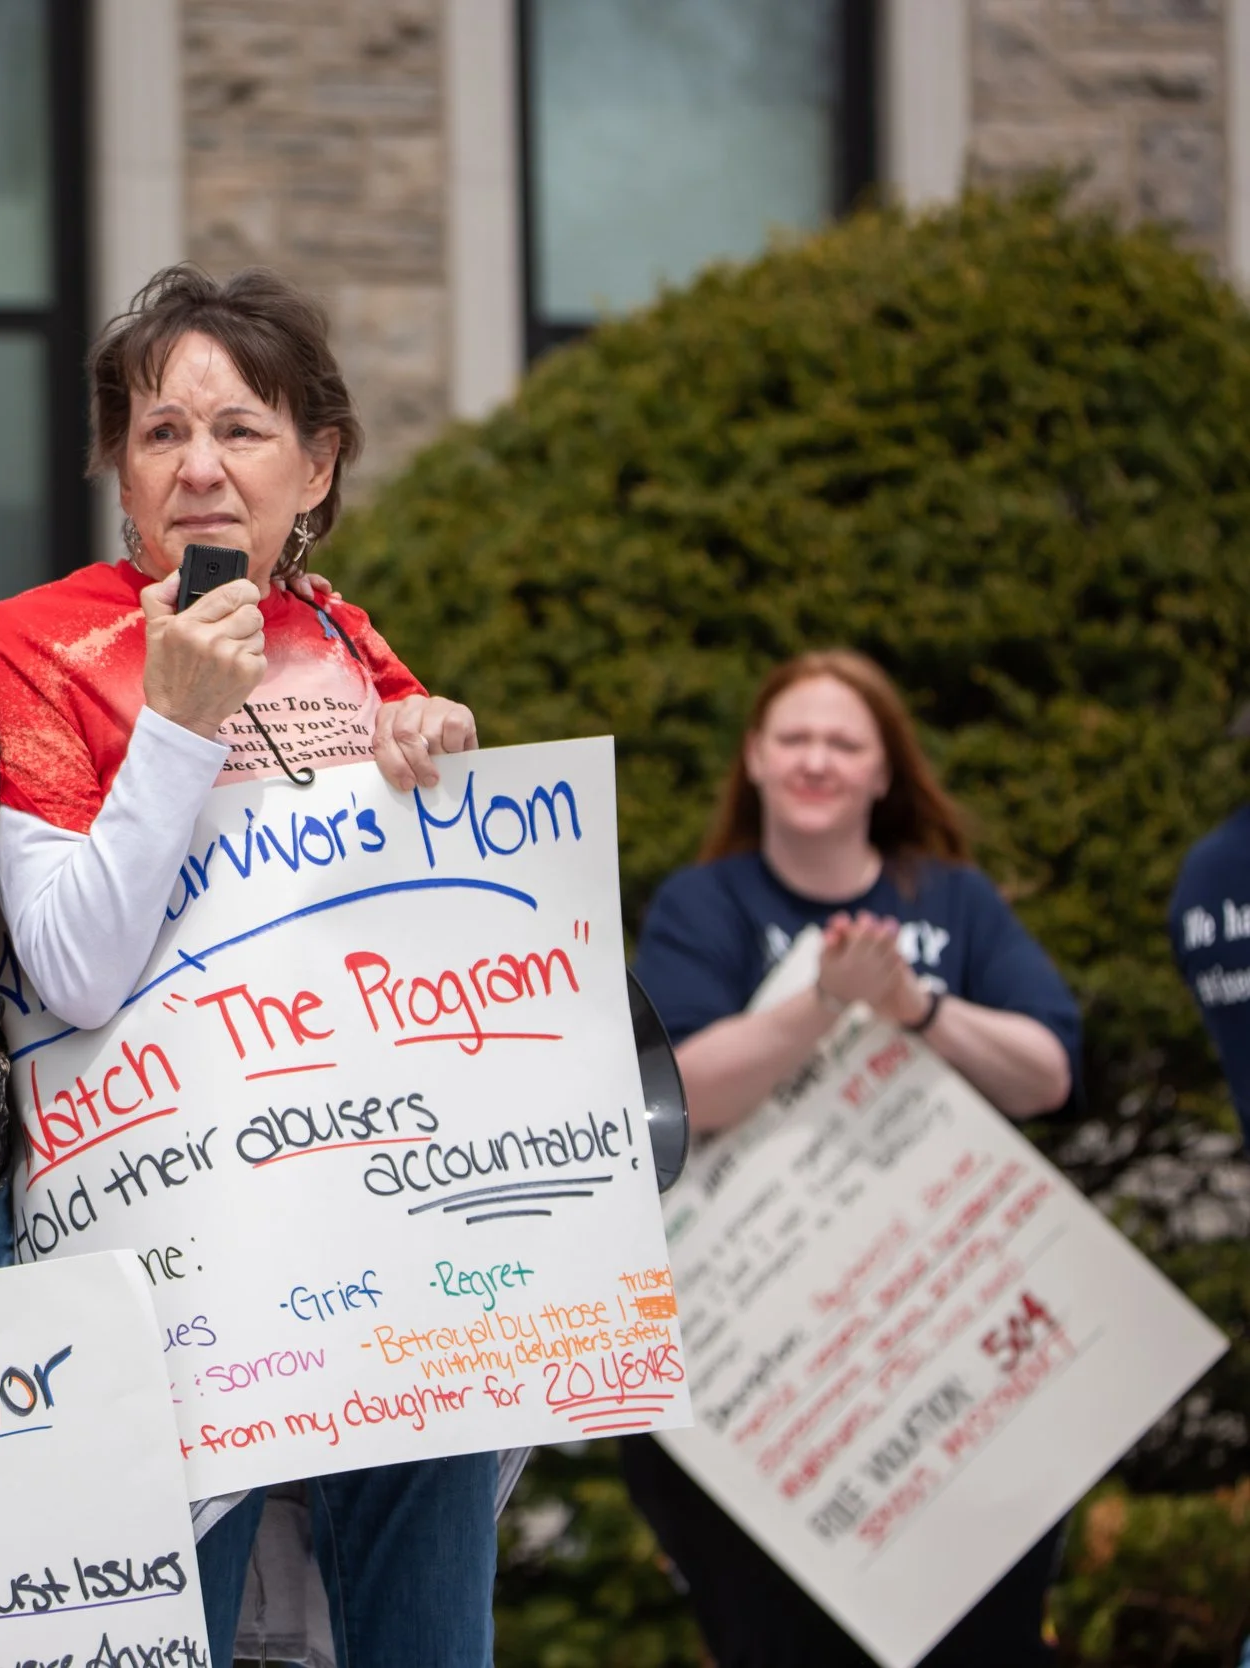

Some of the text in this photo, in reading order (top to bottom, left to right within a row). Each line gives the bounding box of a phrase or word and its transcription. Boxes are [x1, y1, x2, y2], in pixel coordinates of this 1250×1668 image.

[282, 696, 321, 712] Too
[323, 697, 362, 712] Soo
[165, 770, 583, 922] urvivor's Mom
[14, 1092, 439, 1265] Hold their abusers
[363, 1107, 639, 1196] accountable!
[420, 1350, 476, 1380] with
[476, 1350, 516, 1379] my
[615, 1322, 671, 1352] safety
[495, 1311, 543, 1347] by
[540, 1301, 611, 1331] those
[200, 1420, 277, 1454] from
[284, 1412, 340, 1446] my
[343, 1384, 474, 1432] daughter
[483, 1375, 526, 1409] for
[543, 1362, 595, 1406] 20
[601, 1344, 685, 1406] YEARS
[205, 1349, 326, 1393] sorrow
